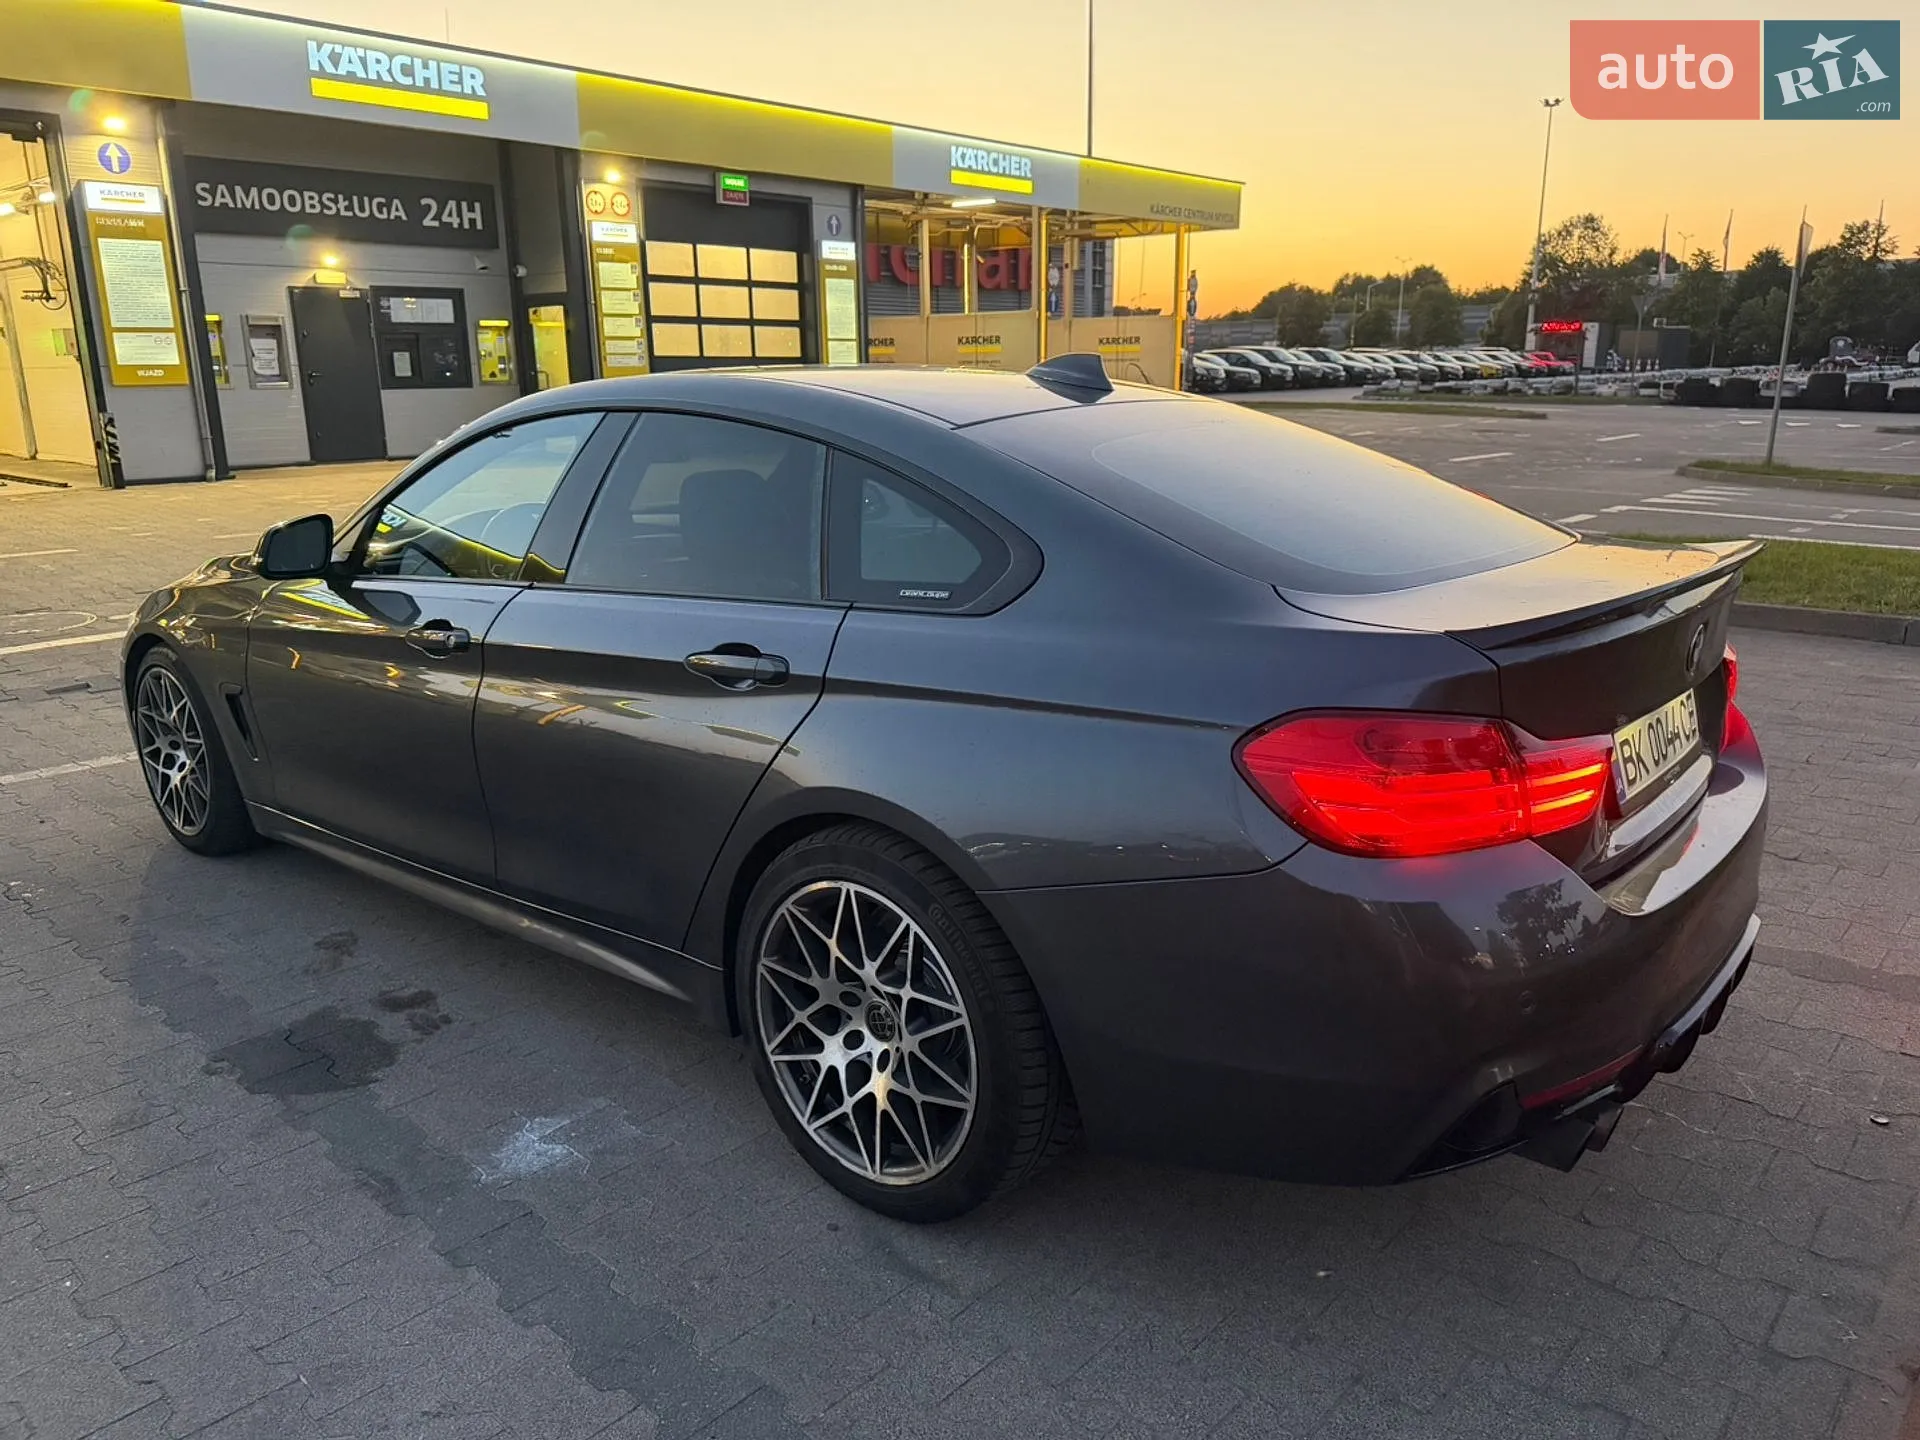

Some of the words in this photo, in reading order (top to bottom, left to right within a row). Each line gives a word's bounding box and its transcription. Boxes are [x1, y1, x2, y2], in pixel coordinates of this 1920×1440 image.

[306, 39, 487, 97] KÄRCHER
[951, 145, 1032, 178] KÄRCHER
[195, 181, 408, 222] SAMOOBSŁUGA
[419, 196, 484, 231] 24H
[1620, 728, 1649, 786] BK
[1647, 705, 1683, 767] 0044
[1680, 692, 1697, 742] CE
